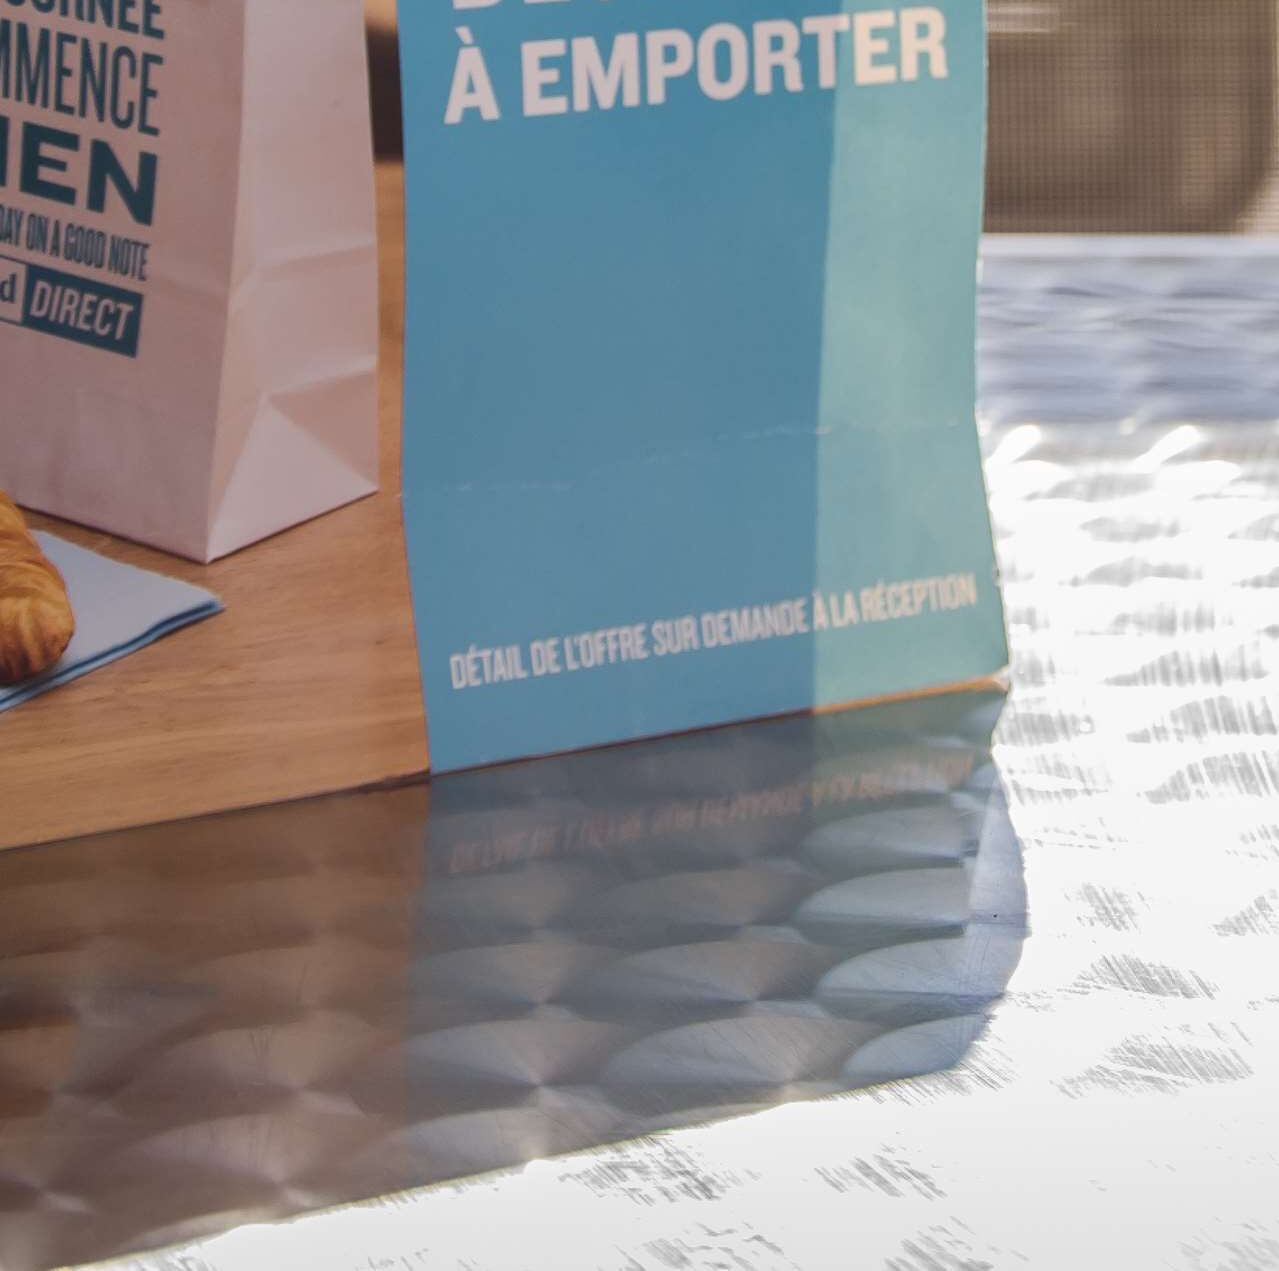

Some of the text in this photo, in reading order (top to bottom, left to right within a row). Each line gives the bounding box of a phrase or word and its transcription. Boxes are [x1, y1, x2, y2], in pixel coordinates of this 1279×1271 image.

[444, 7, 948, 124] À EMPORTER
[26, 214, 48, 253] ON
[49, 220, 60, 257] A
[64, 223, 105, 269] GOOD
[109, 235, 150, 281] NOTE
[30, 280, 134, 341] DIRECT
[450, 573, 977, 690] DÉTAIL DE L'OFFRE SUR DEMANDE À LA RÉCEPTION
